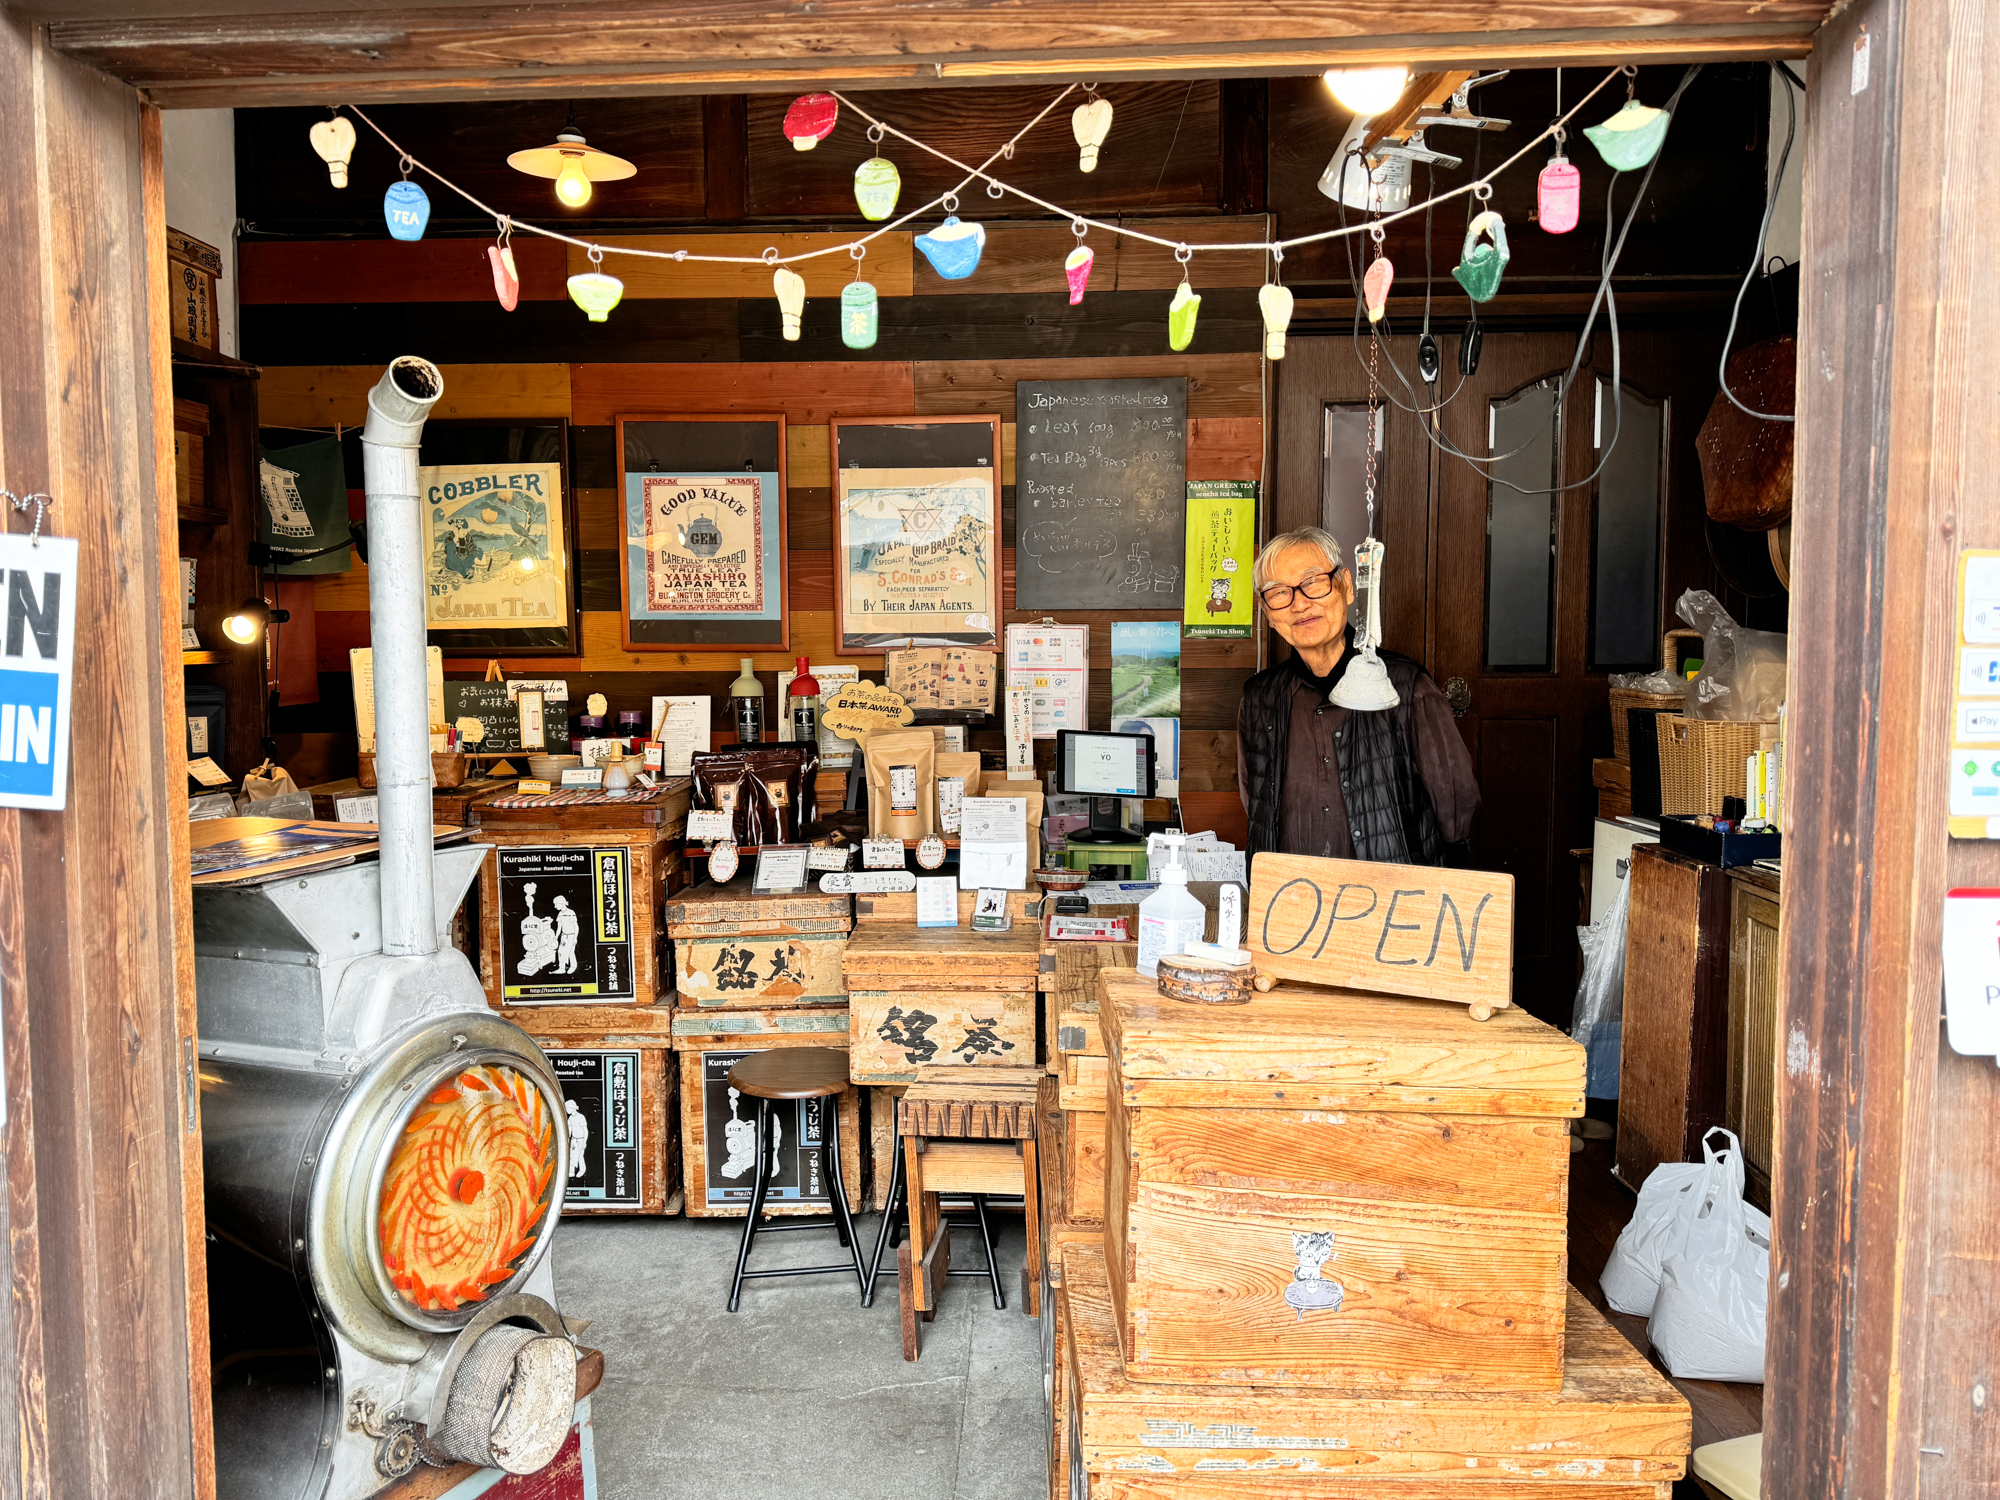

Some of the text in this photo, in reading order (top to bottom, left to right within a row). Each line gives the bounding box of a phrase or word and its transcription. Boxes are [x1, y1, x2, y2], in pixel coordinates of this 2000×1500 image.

[865, 191, 889, 203] TEA
[392, 209, 420, 226] TEA
[849, 311, 868, 336] 茶
[1028, 393, 1094, 411] Japanese
[1166, 429, 1182, 441] yen
[1065, 451, 1087, 468] Bag
[428, 473, 543, 505] COBBLER
[1026, 480, 1074, 495] Roasted
[1231, 490, 1243, 498] bag
[660, 487, 747, 517] GOOD VALUE
[913, 511, 927, 529] C
[690, 532, 718, 545] GEM
[1210, 510, 1220, 573] 煎茶ティーバッグ
[878, 536, 956, 558] JAPAN CHIP BRAID
[661, 549, 746, 565] CAREFULLY PREPARED
[874, 555, 949, 567] ESPECIALLY MANUFACTURED
[664, 573, 747, 581] YAMASHIRO
[719, 580, 747, 588] TEA
[658, 591, 704, 600] BULINGTON
[706, 591, 740, 599] GROCERY
[435, 595, 550, 618] JAPAN TEA
[863, 599, 975, 611] BY THEIR JAPAN AGENTS.
[1119, 626, 1175, 638] 風の奏の君へ
[1228, 628, 1245, 636] Shop
[846, 688, 899, 706] お茶の品評会
[838, 699, 902, 714] 日本茶AWARD
[503, 854, 585, 863] Kurashiki Houji-cha
[827, 873, 854, 888] 受賞
[602, 856, 619, 936] 倉敷ほうじ茶
[1262, 877, 1494, 972] OPEN
[606, 946, 619, 991] つねき茶舗
[529, 986, 572, 994] http://tsuneki.net
[557, 1059, 596, 1067] Houji-cha
[612, 1062, 627, 1141] 倉敷ほうじ茶
[615, 1152, 625, 1197] つねき茶舗
[809, 1151, 820, 1195] つねき茶舗
